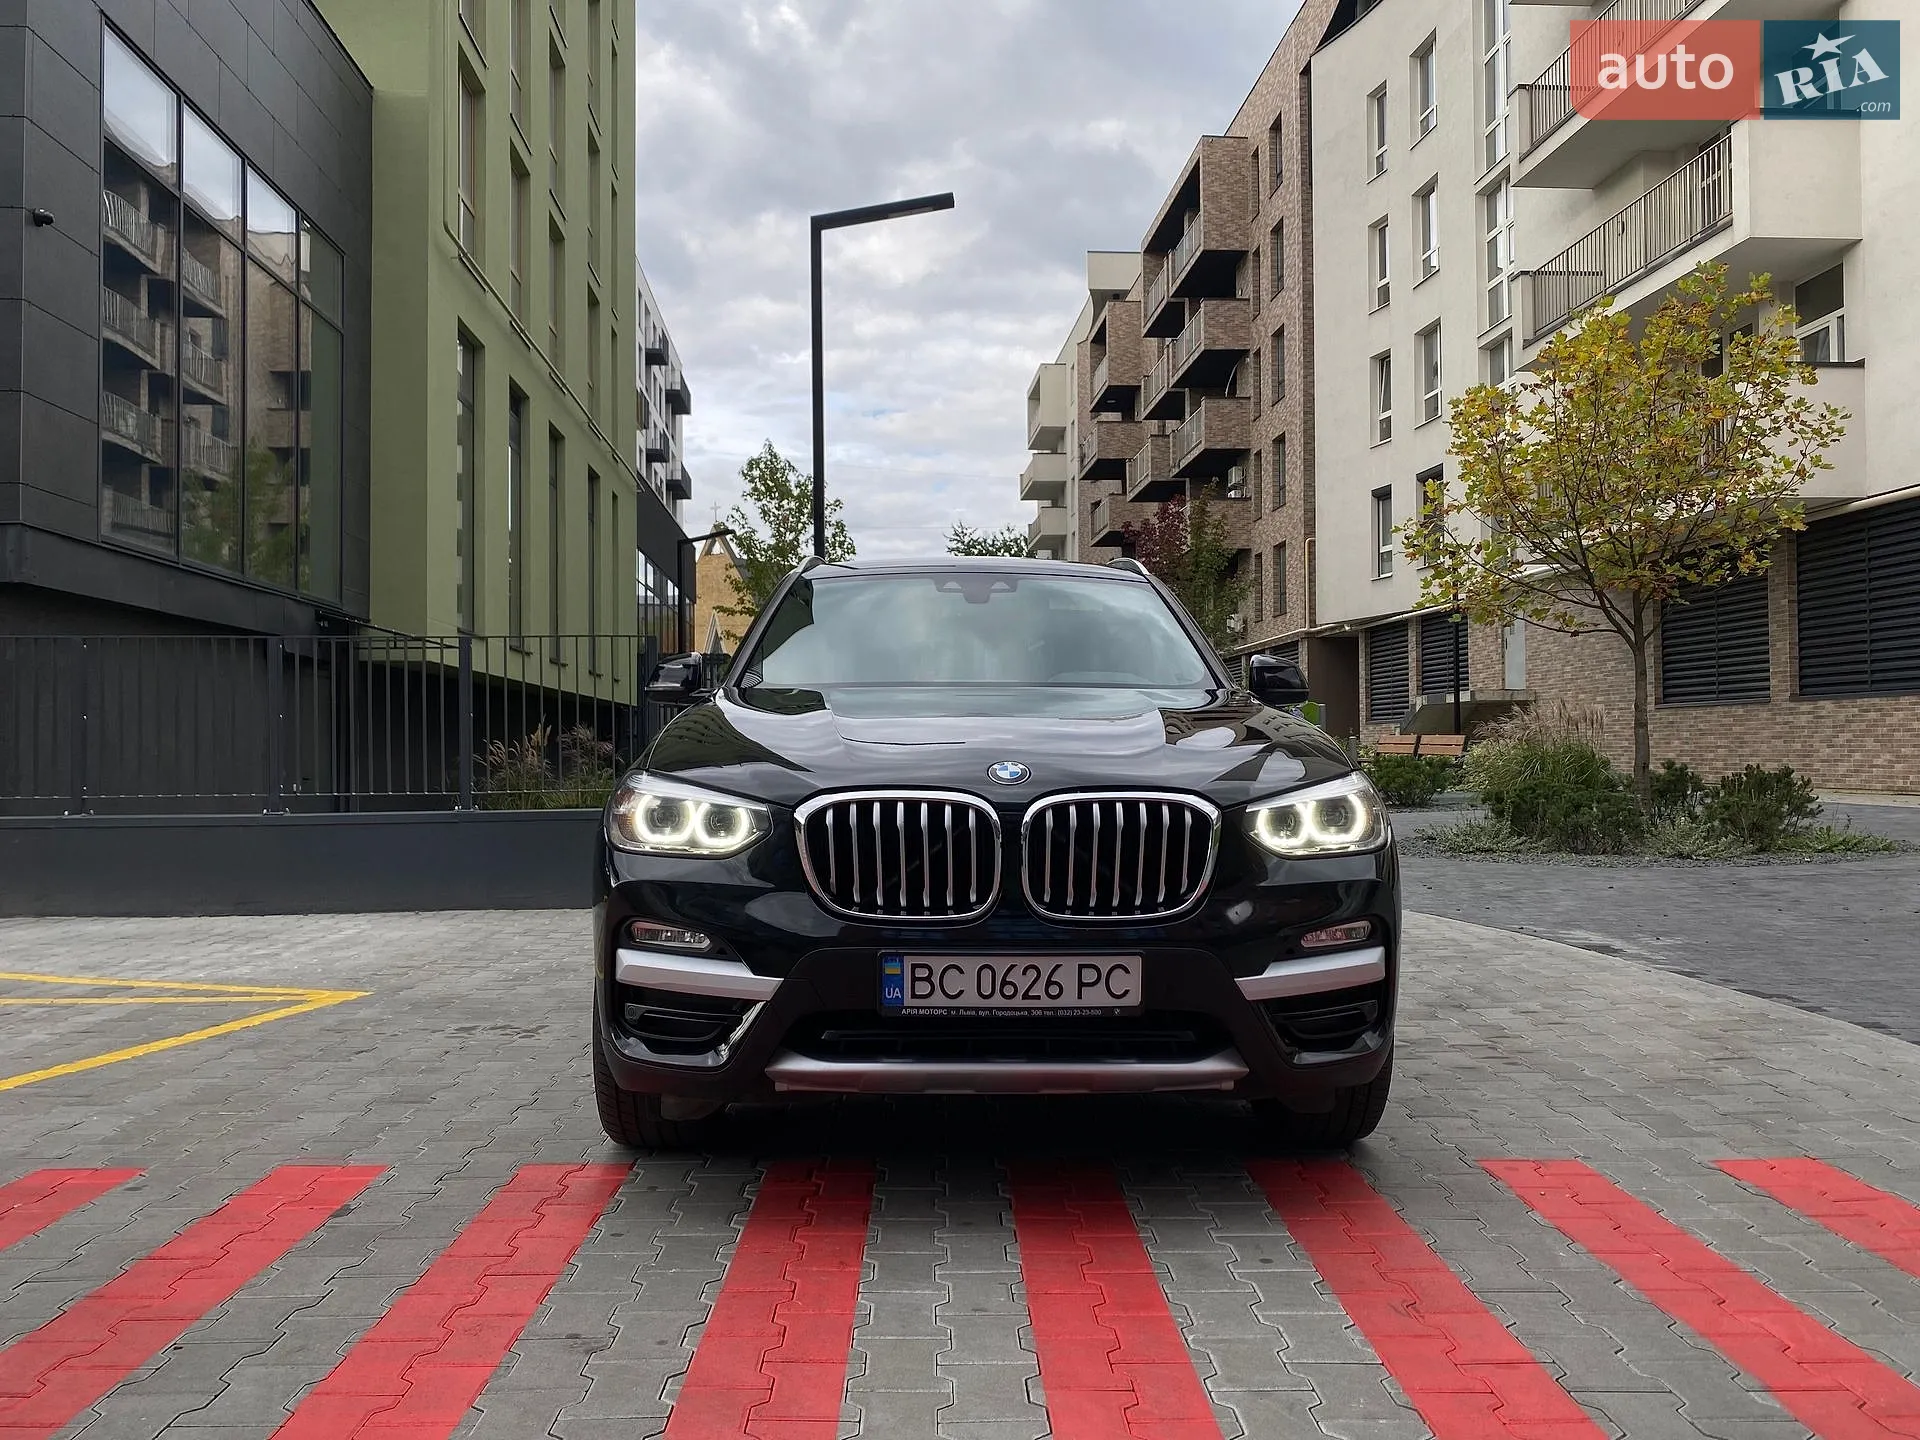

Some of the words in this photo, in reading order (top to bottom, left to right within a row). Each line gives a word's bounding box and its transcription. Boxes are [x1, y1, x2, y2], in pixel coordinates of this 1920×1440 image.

[885, 988, 901, 999] UA
[910, 963, 965, 1000] BC
[975, 963, 1064, 1000] 0626
[1076, 963, 1131, 1000] PC
